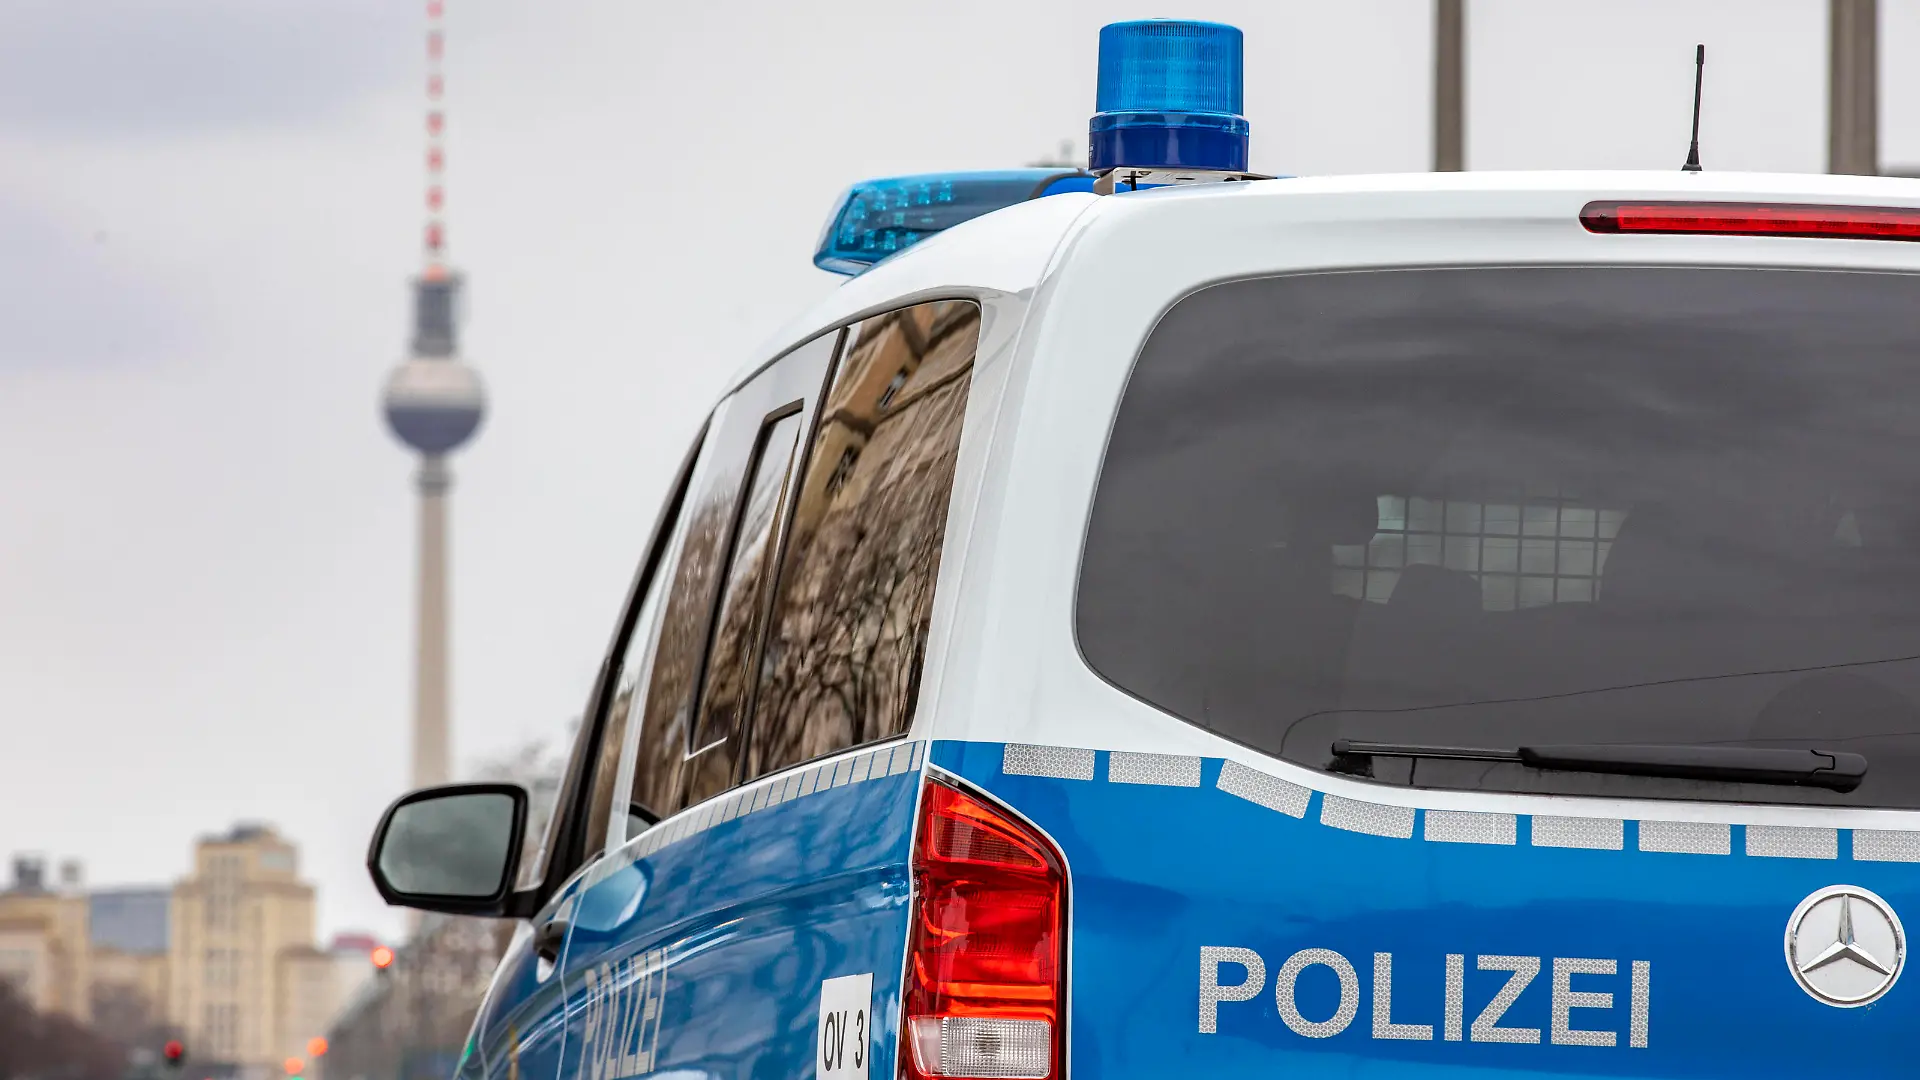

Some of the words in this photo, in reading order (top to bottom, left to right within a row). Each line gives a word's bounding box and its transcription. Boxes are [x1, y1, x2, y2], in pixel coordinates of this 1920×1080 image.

[577, 947, 668, 1080] POLIZEI
[823, 1010, 847, 1072] OV
[855, 1009, 864, 1069] 3
[1198, 945, 1651, 1048] POLIZEI
